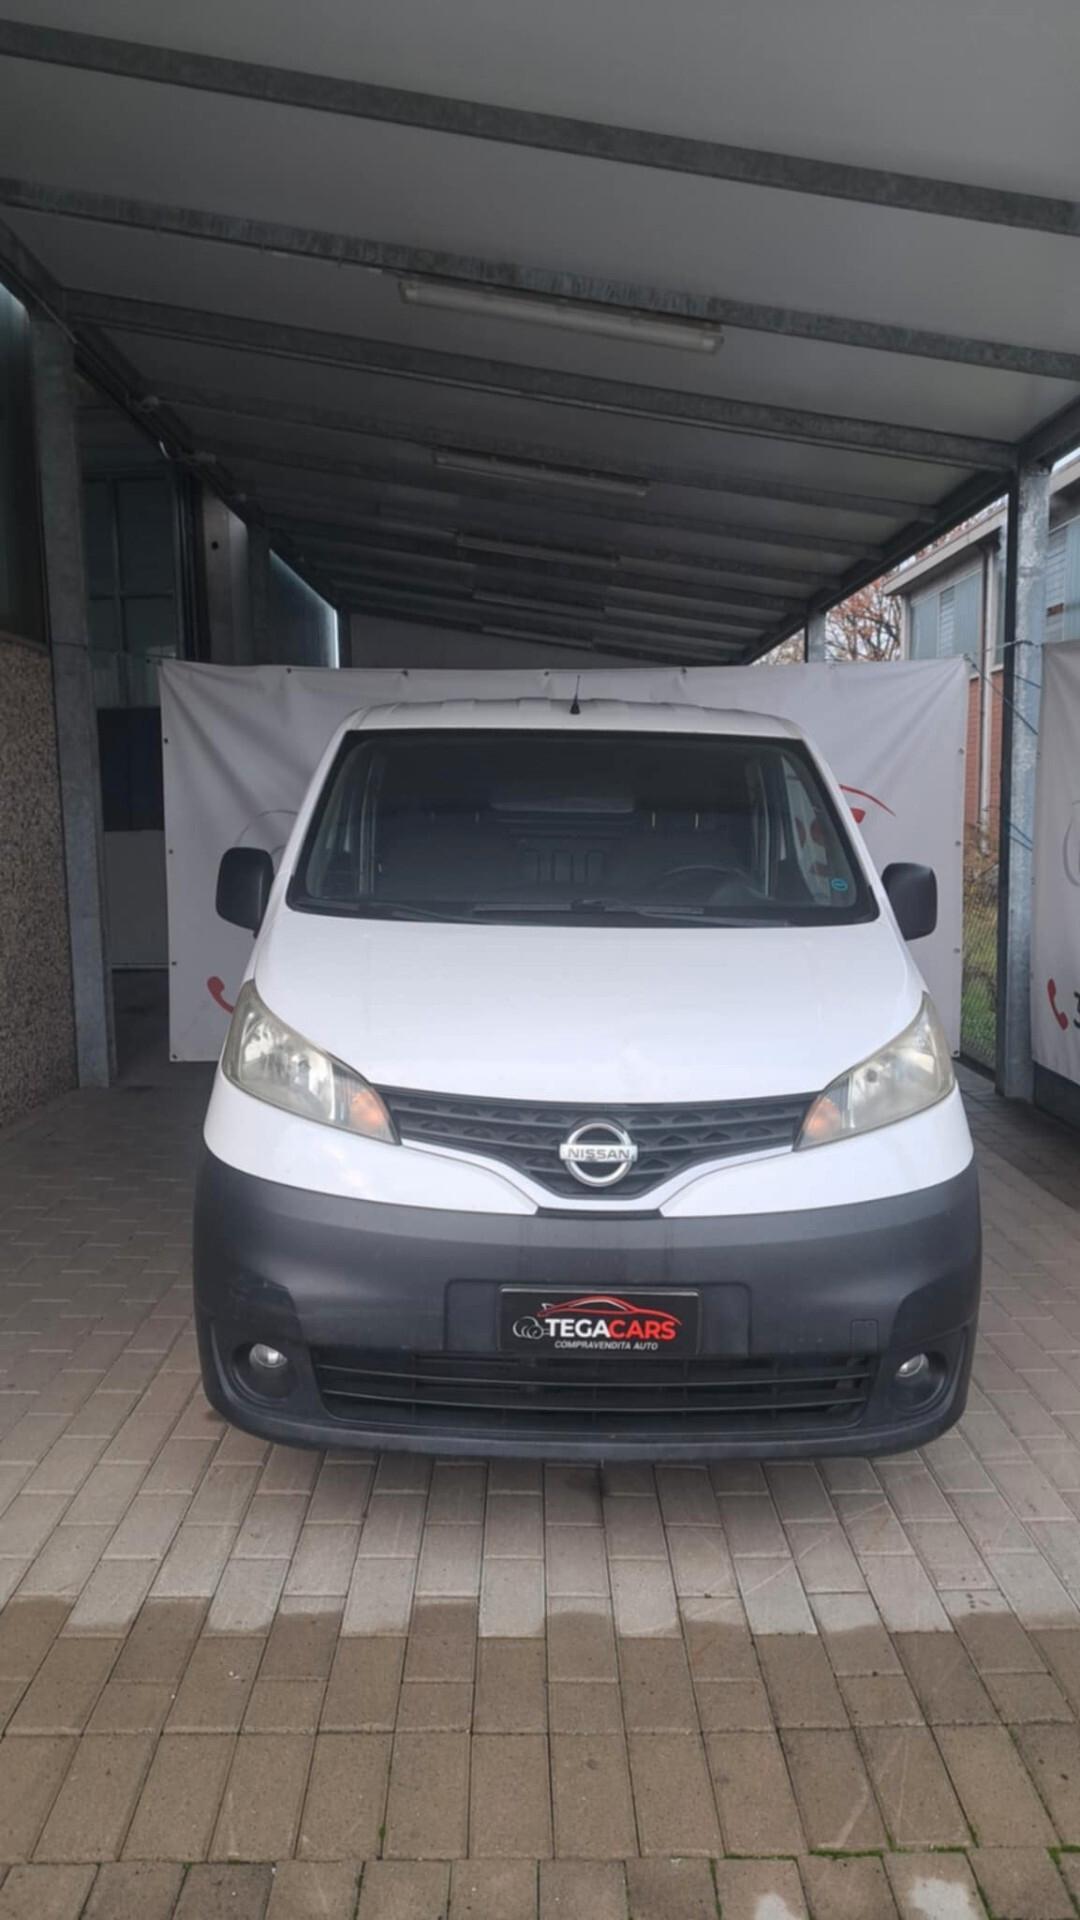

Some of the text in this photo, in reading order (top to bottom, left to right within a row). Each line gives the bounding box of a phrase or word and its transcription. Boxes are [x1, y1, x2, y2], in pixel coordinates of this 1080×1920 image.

[567, 1147, 630, 1160] NISSAN
[545, 1318, 677, 1340] TEGACARS
[554, 1340, 658, 1351] COMPRAVENDITA AUTO
